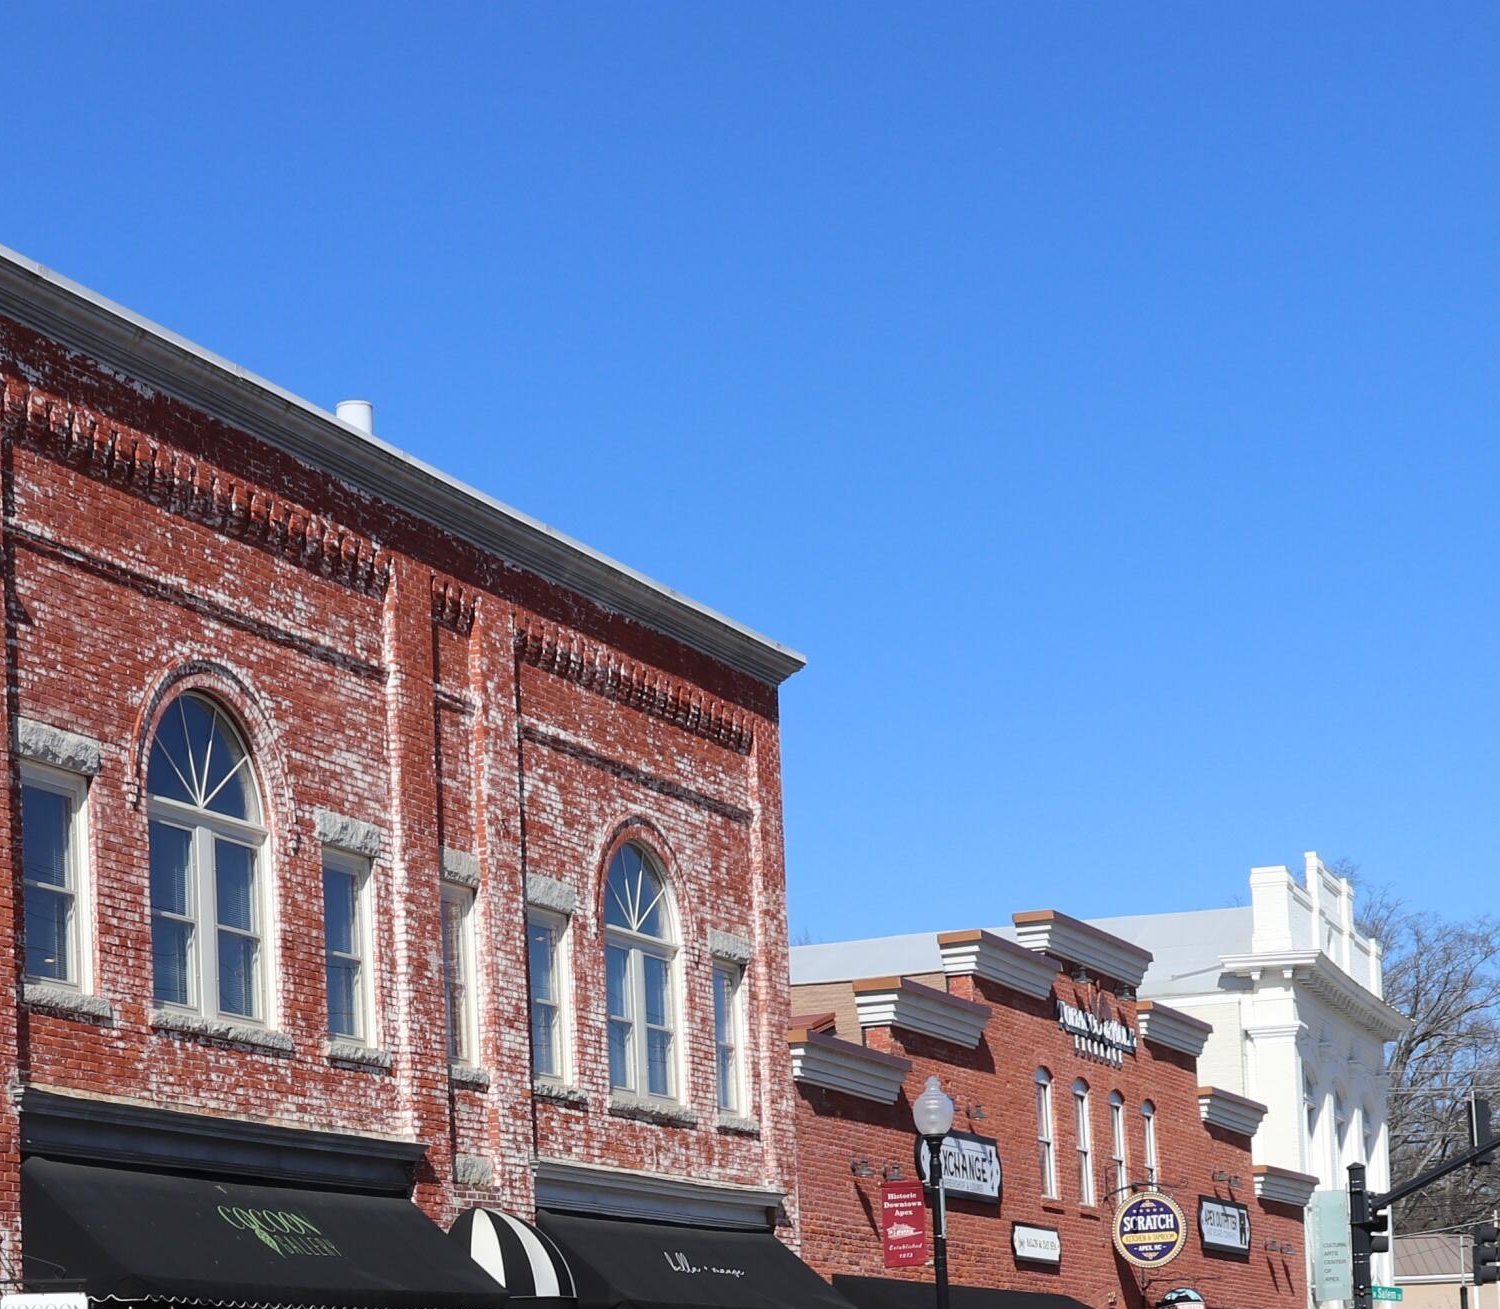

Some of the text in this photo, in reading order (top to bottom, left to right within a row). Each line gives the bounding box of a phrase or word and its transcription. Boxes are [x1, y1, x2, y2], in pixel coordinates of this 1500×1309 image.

[942, 1150, 988, 1183] XCHANGE
[217, 1205, 322, 1235] COCOON
[1123, 1213, 1175, 1231] SCRATCH
[273, 1234, 342, 1257] GALLERY
[1378, 1287, 1396, 1299] Salem
